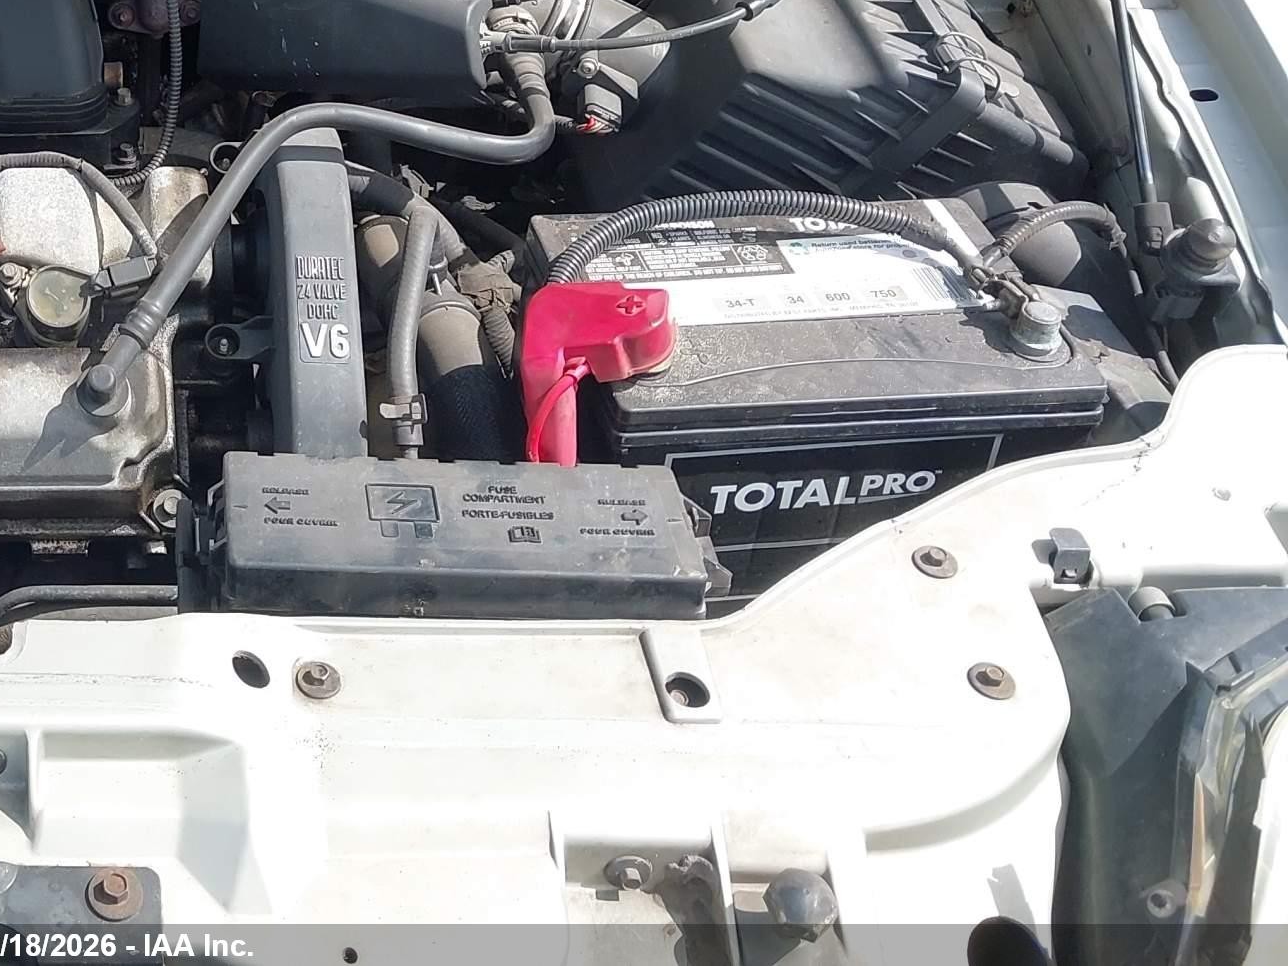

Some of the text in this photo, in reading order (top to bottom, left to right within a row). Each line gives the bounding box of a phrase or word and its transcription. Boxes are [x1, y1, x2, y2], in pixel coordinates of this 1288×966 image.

[295, 256, 345, 280] DURATEC
[296, 283, 347, 301] 24 VALVE
[825, 292, 851, 302] 600
[870, 289, 897, 298] 750
[727, 297, 755, 308] 34-T
[787, 295, 805, 305] 34
[306, 303, 339, 320] DOHC
[300, 322, 350, 359] V6
[488, 485, 517, 494] FUSE
[462, 494, 546, 504] COMPARTMENT
[462, 509, 554, 521] PORTE-FUSIBLES
